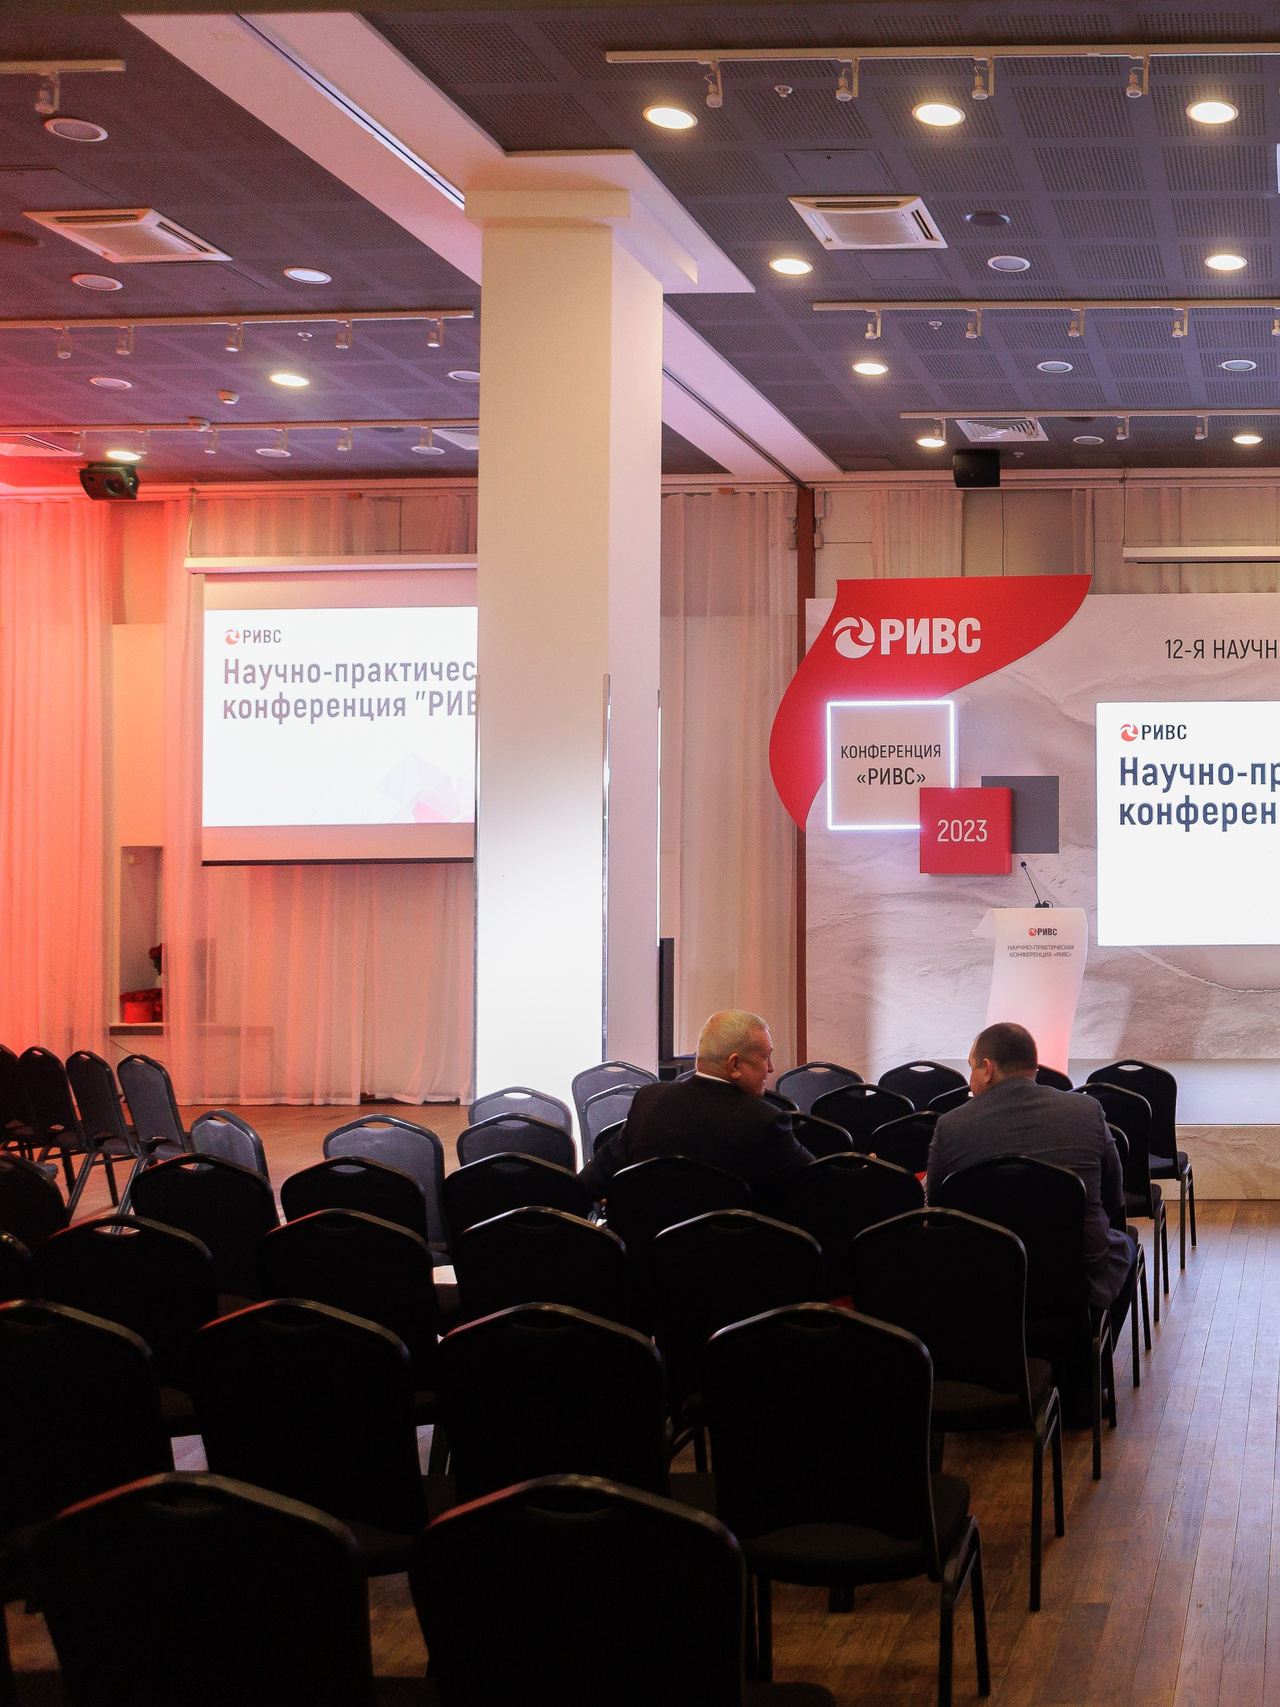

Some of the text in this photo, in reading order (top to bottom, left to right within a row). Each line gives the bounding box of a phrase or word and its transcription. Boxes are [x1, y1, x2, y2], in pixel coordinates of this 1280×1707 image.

[242, 629, 282, 643] РИВС
[880, 617, 981, 655] РИВС
[1165, 639, 1205, 659] 12-Я
[224, 658, 476, 690] Научно-практичес
[223, 692, 406, 725] конференция
[1141, 724, 1187, 740] РИВС
[840, 744, 942, 760] КОНФЕРЕНЦИЯ
[856, 766, 926, 786] «РИВС»
[937, 819, 988, 843] 2023
[1037, 928, 1058, 936] РИВС
